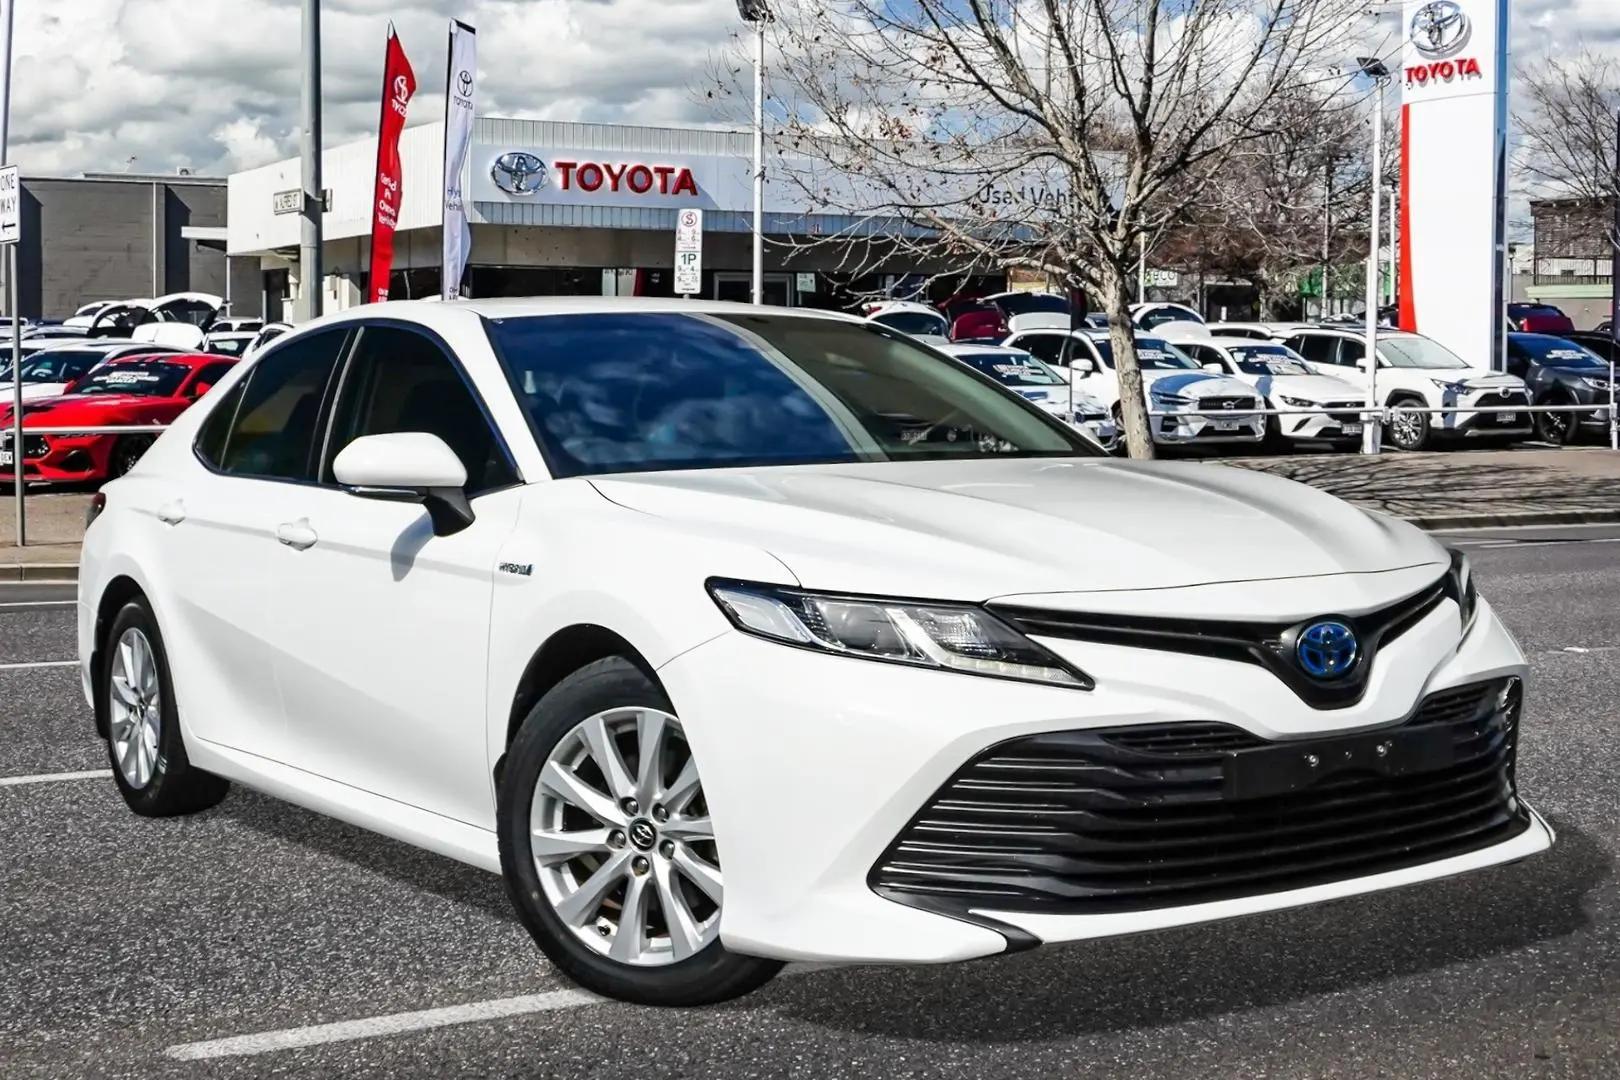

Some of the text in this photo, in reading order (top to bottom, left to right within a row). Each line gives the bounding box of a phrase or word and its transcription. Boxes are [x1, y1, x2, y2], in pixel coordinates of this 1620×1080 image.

[1404, 58, 1480, 82] TOYOTA
[0, 173, 17, 191] ONE
[555, 161, 698, 196] TOYOTA
[0, 196, 16, 214] WAY
[681, 253, 697, 265] 1P
